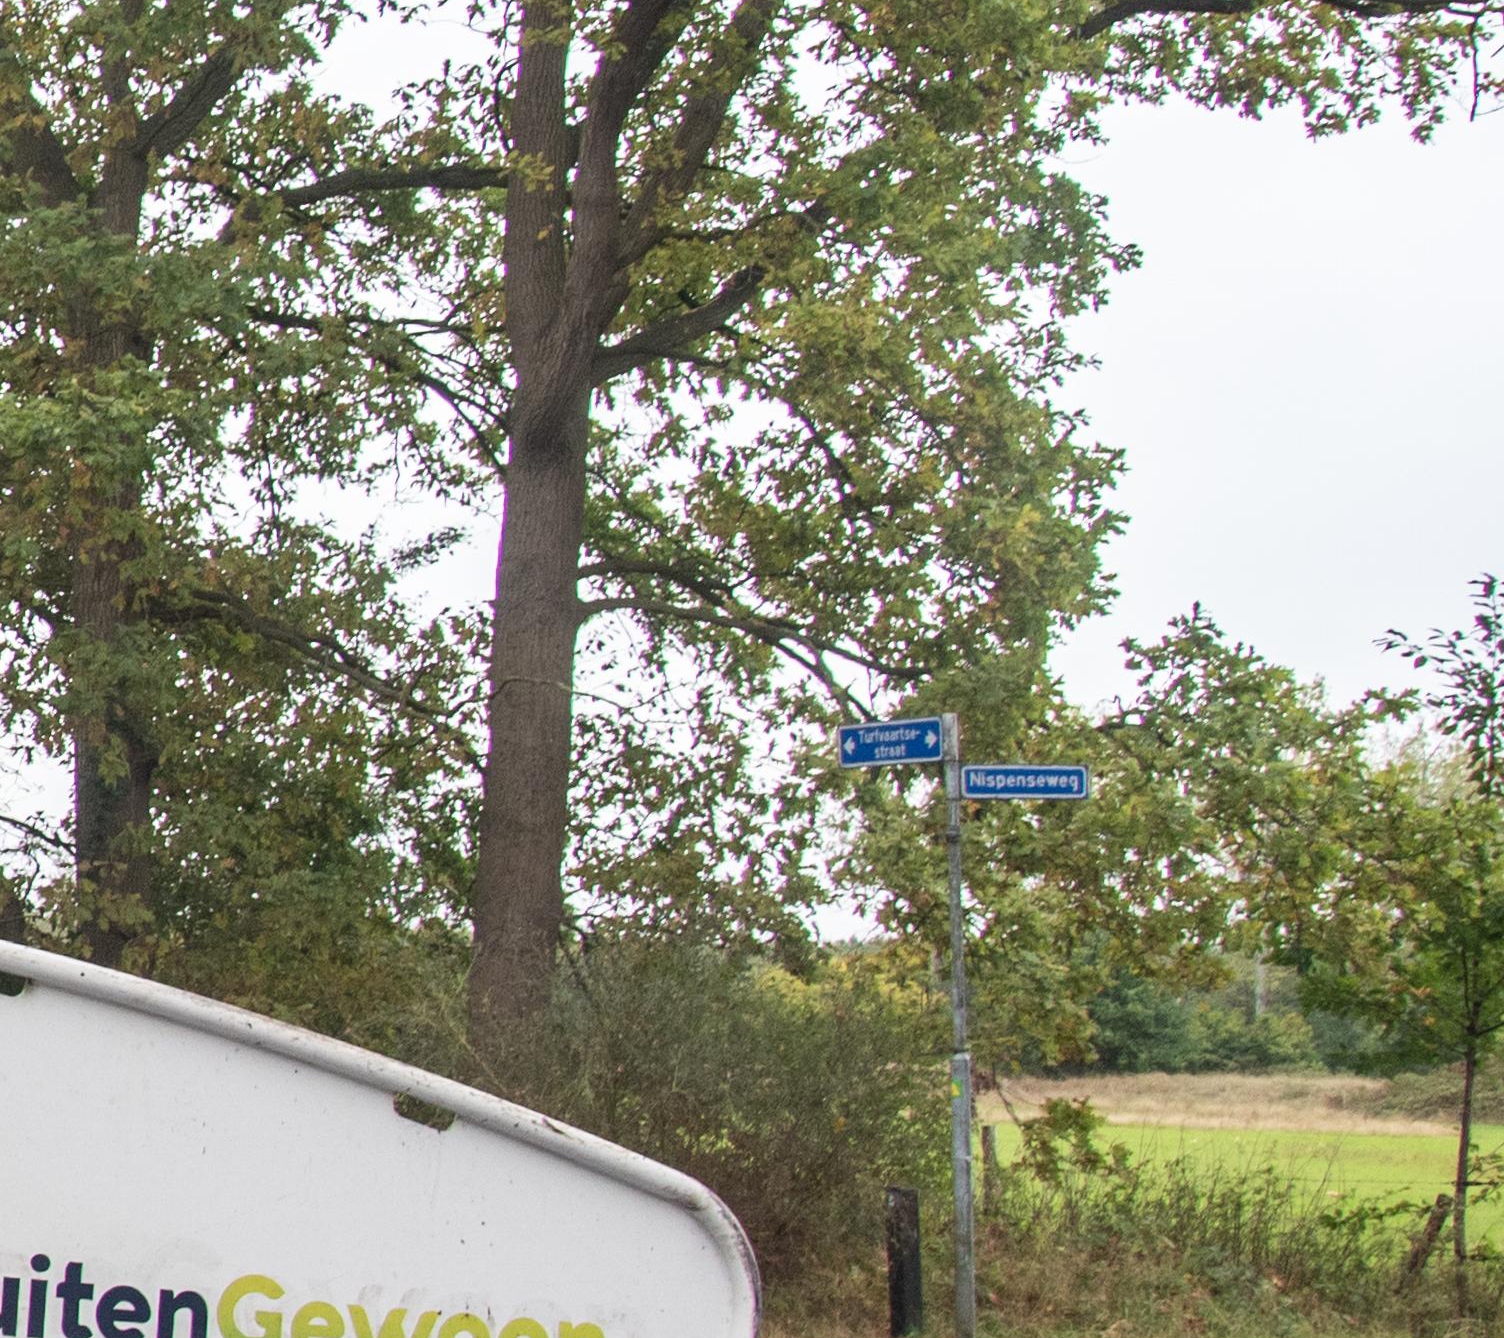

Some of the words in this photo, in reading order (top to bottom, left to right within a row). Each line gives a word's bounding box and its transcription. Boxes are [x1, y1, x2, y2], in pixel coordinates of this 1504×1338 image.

[858, 728, 922, 745] Turfvaartse-
[874, 745, 906, 759] straat
[969, 771, 1079, 791] Nispenseweg
